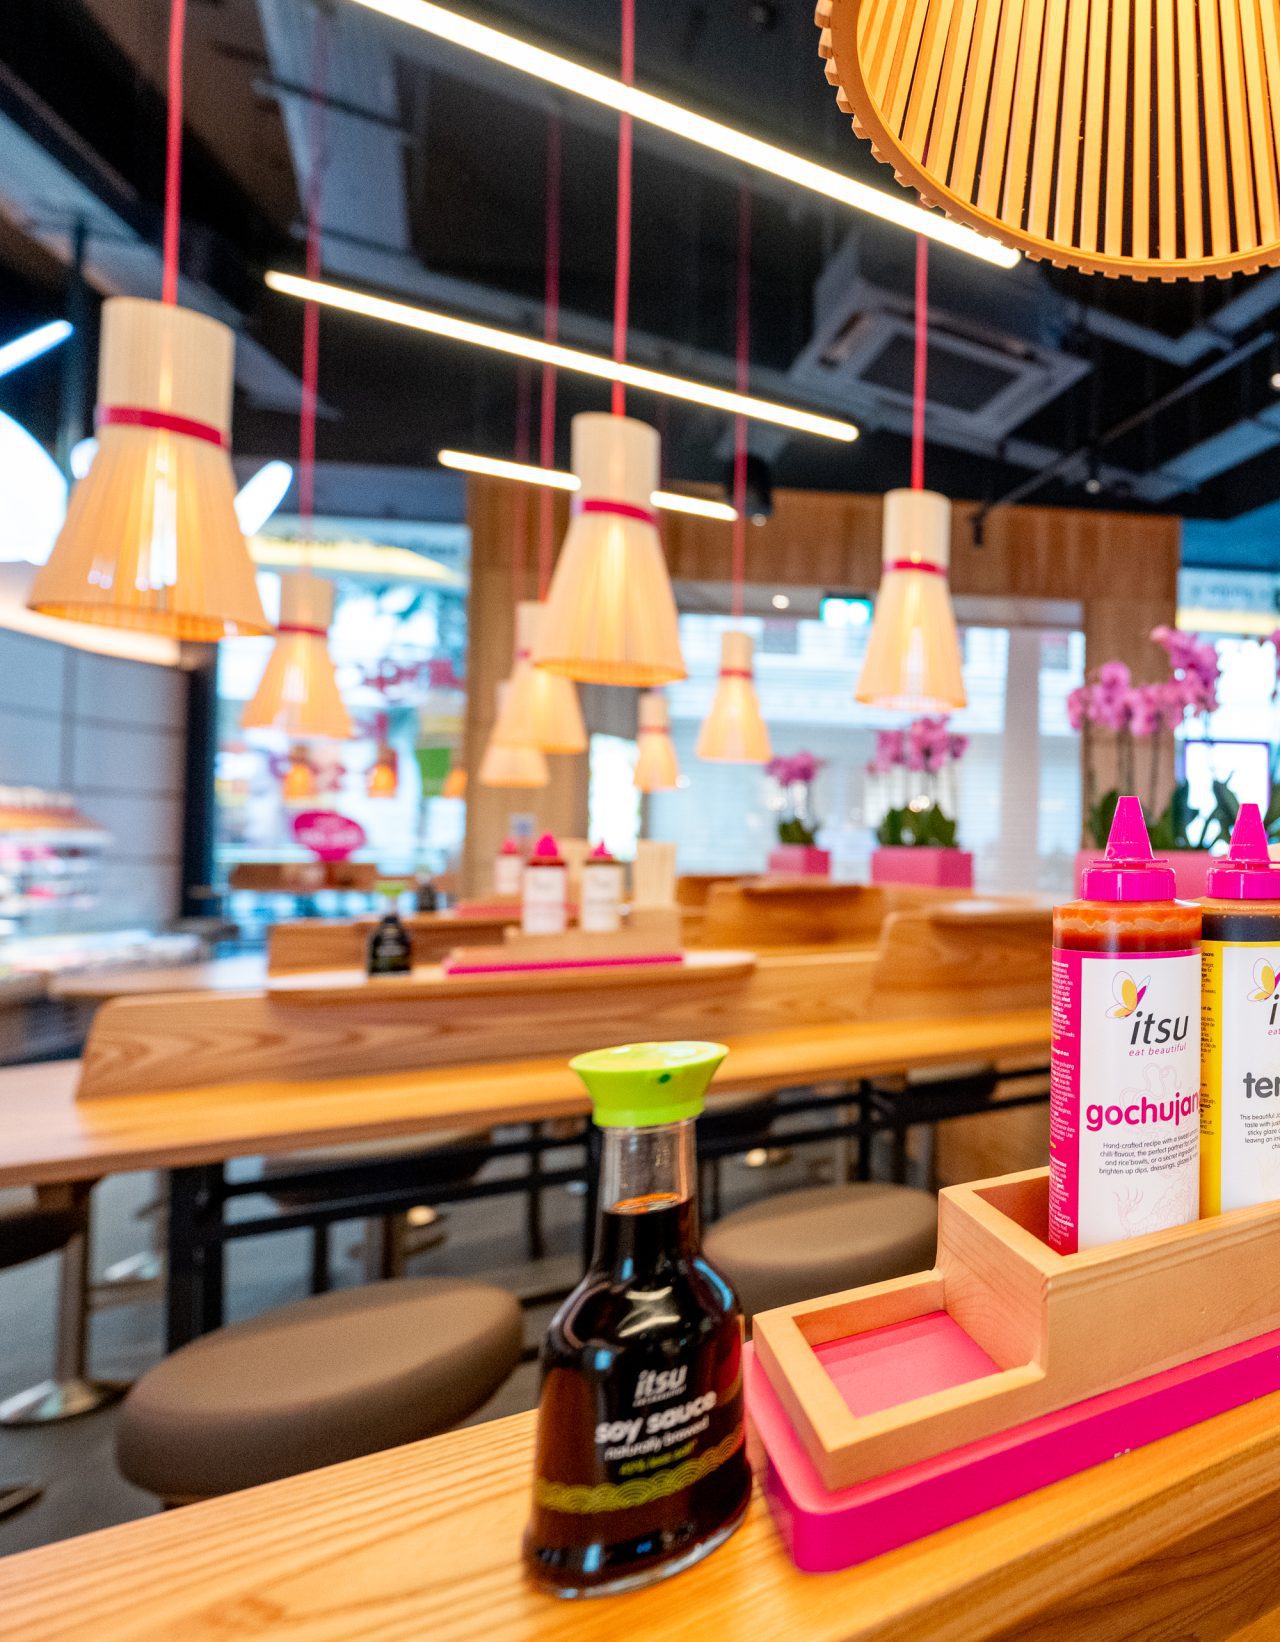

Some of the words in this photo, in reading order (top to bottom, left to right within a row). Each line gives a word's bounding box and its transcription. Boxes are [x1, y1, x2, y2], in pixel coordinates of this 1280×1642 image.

[1130, 1011, 1189, 1045] itsu
[1268, 1028, 1280, 1036] eat
[1129, 1048, 1145, 1057] eat
[1149, 1043, 1187, 1056] beautiful
[1086, 1091, 1200, 1132] gochujan
[1144, 1139, 1161, 1148] recipe
[1162, 1136, 1173, 1144] with
[634, 1365, 688, 1399] itsu
[594, 1417, 644, 1447] soy
[645, 1390, 718, 1435] sauce
[604, 1434, 663, 1461] naturally
